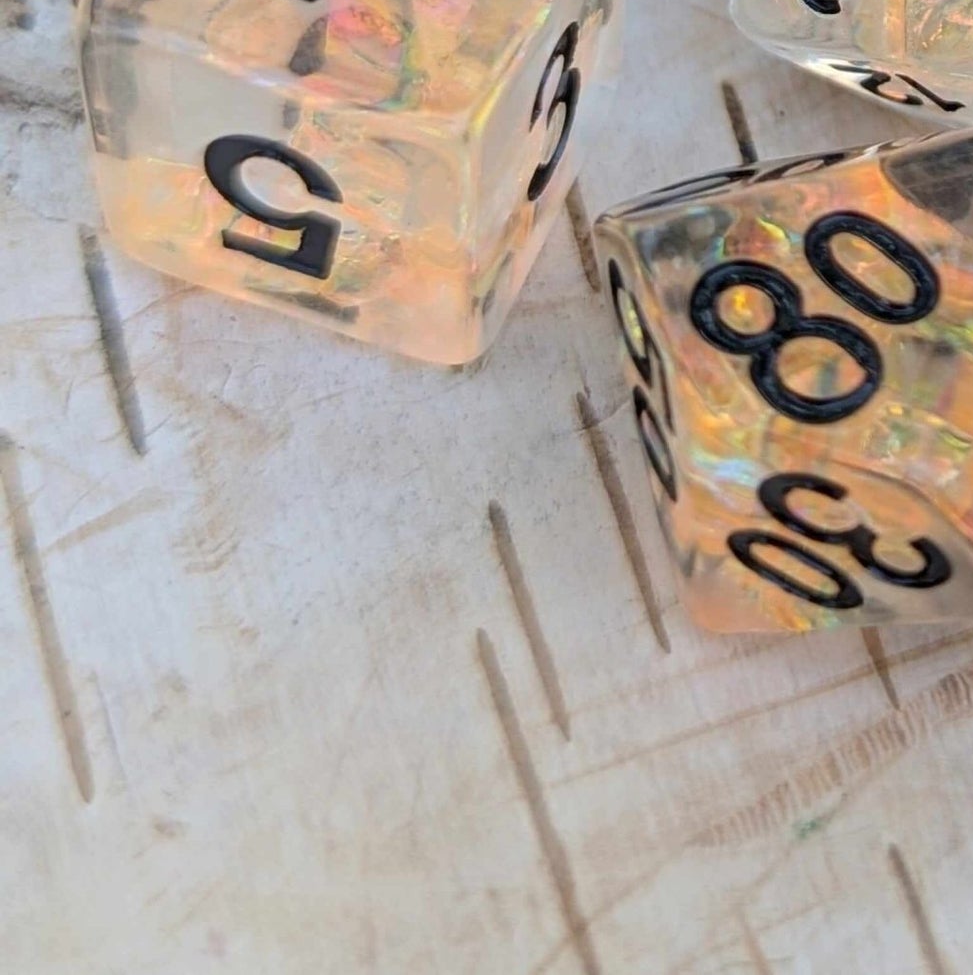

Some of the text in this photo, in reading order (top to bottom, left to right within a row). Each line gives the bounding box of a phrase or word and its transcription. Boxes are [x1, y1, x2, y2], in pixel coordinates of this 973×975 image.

[527, 21, 581, 202] 3
[205, 135, 343, 280] 5
[690, 210, 940, 423] 80
[727, 472, 952, 609] 30
